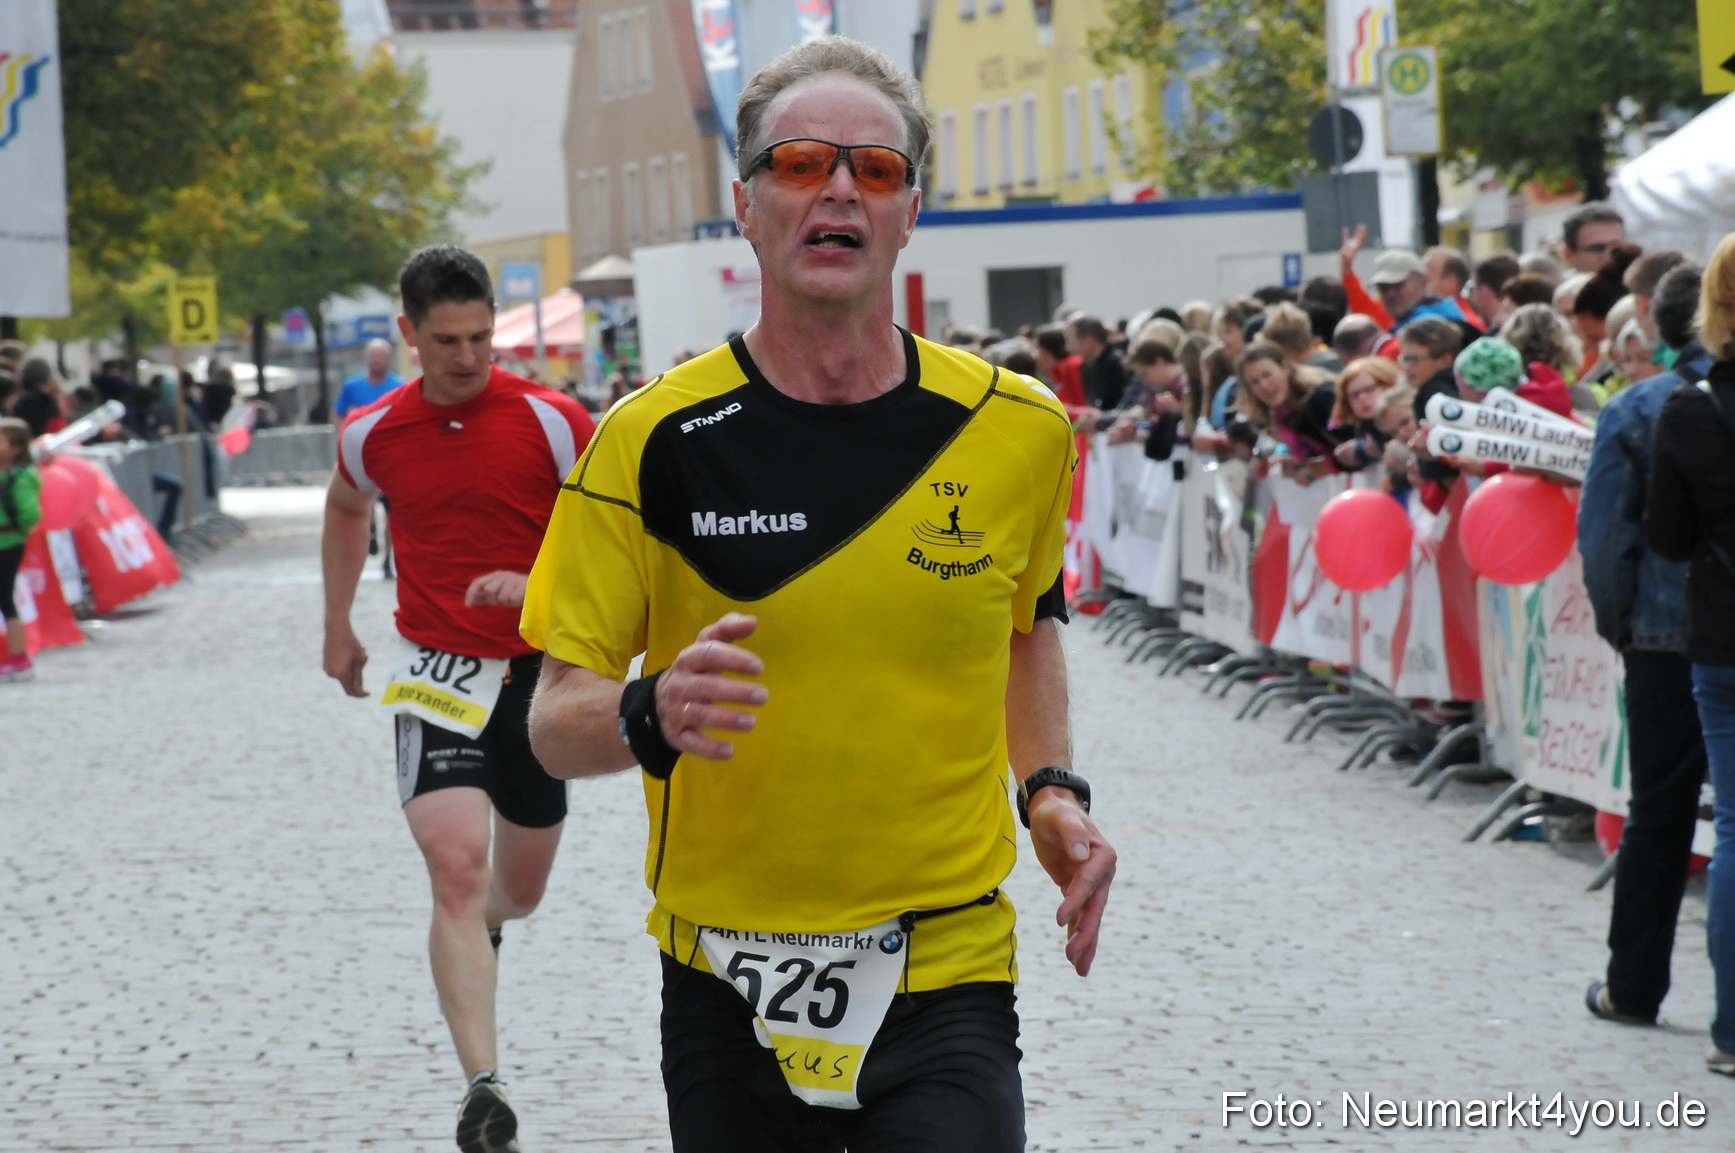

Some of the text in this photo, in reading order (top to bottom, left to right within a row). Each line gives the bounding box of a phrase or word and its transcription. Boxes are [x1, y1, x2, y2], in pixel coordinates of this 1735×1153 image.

[182, 298, 206, 331] D
[680, 402, 743, 434] STANNO
[1475, 408, 1529, 435] BMW
[1476, 439, 1530, 463] BMW
[929, 481, 969, 498] TSV
[691, 509, 808, 537] Markus
[906, 546, 994, 581] Burgthann
[410, 646, 483, 695] 302
[772, 931, 874, 951] Neumarkt
[726, 950, 857, 1029] 525
